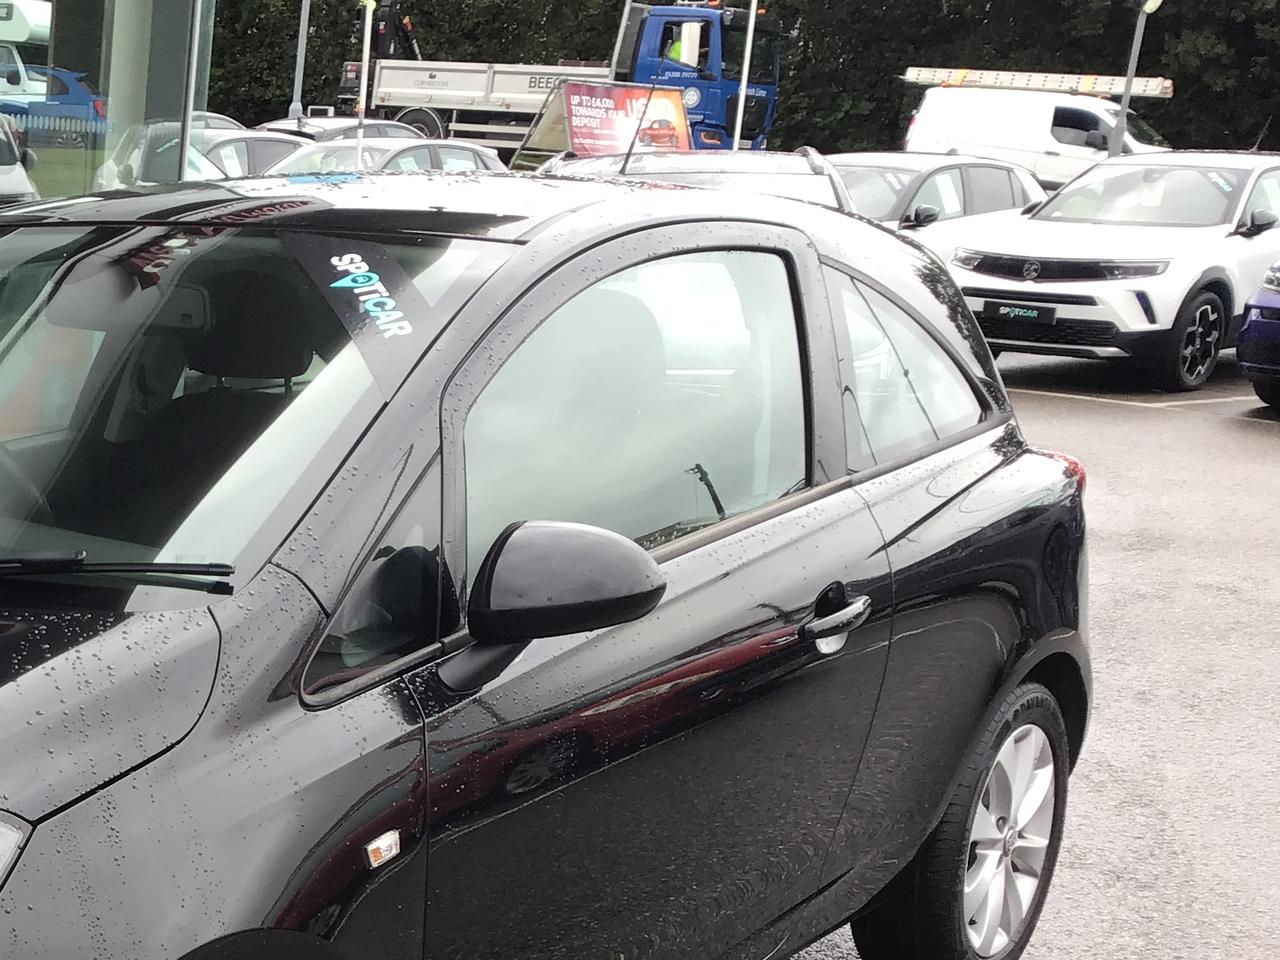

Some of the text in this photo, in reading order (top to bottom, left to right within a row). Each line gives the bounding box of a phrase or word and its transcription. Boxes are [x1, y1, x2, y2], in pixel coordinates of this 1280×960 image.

[570, 95, 580, 105] UP
[580, 96, 591, 106] TO
[571, 105, 607, 118] TOWARDS
[572, 116, 601, 128] DEPOSIT
